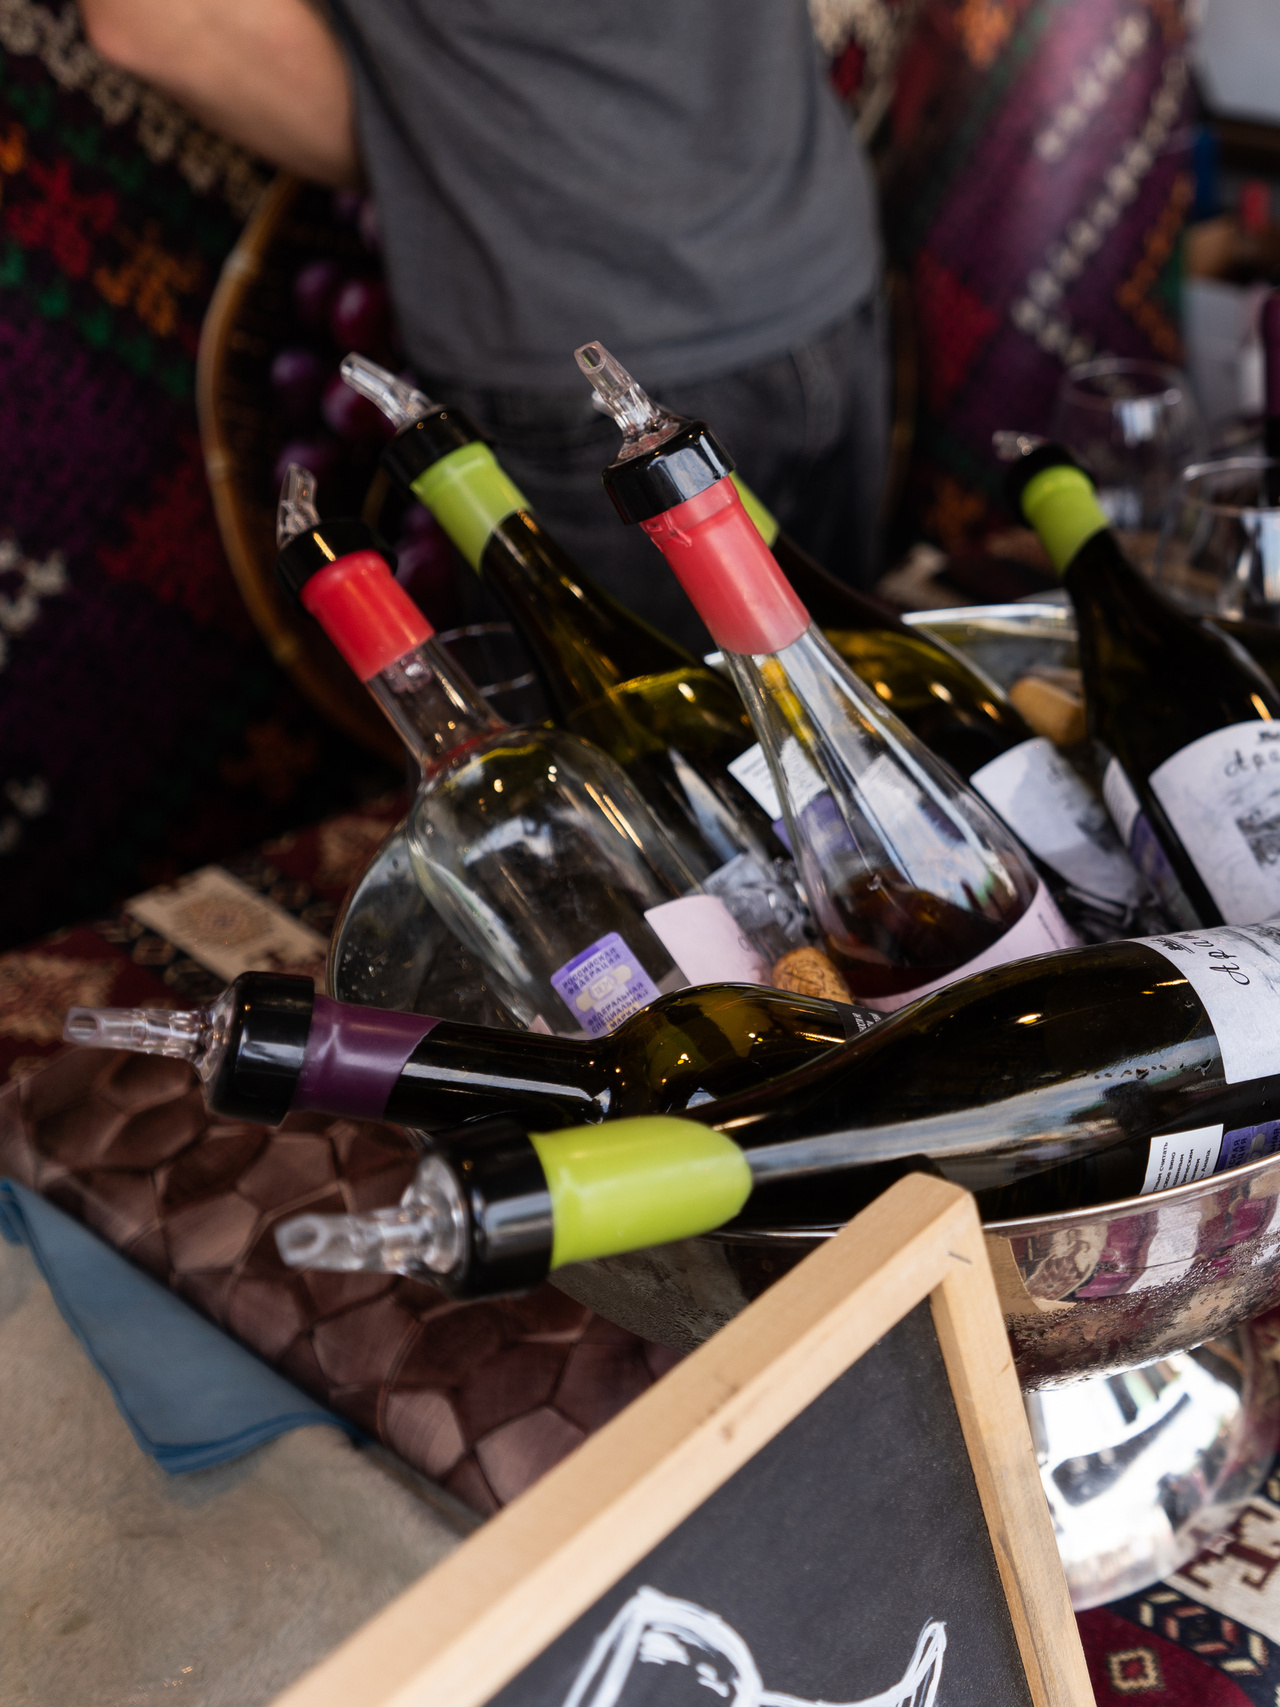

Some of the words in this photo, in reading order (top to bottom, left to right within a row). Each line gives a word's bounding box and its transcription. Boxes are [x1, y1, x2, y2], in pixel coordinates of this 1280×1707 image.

[562, 947, 616, 989] РОССИЙСКАЯ
[567, 953, 621, 995] ФЕДЕРАЦИЯ
[587, 982, 644, 1026] ФЕДЕРАЛЬНАЯ
[591, 990, 649, 1034] СПЕЦИАЛЬНАЯ
[609, 1006, 637, 1029] МАРКА
[1160, 1142, 1168, 1172] считать
[1228, 1139, 1240, 1168] СКАЯ
[1236, 1138, 1247, 1166] АЦИЯ
